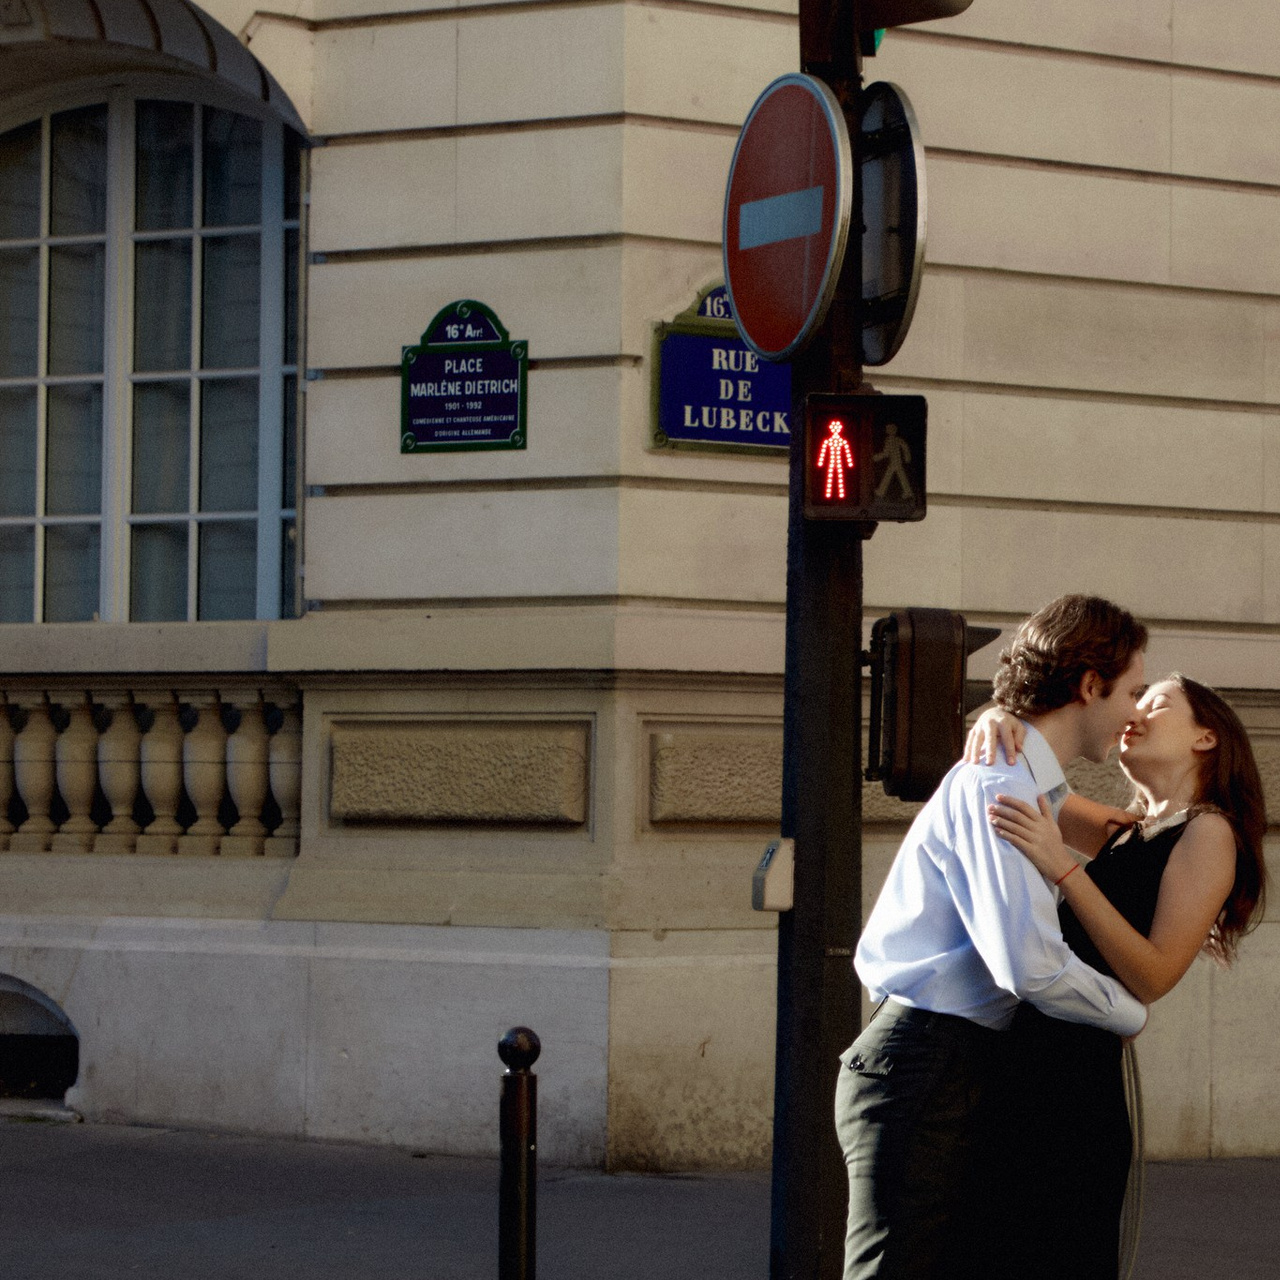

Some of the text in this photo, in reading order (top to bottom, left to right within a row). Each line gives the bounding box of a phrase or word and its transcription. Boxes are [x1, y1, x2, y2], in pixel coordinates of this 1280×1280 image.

[444, 358, 483, 374] PLACE
[711, 348, 760, 373] RUE
[464, 378, 518, 396] DIETRICH
[718, 378, 752, 402] DE
[445, 402, 460, 411] 1901
[466, 401, 482, 410] 1992
[683, 404, 791, 434] LUBECK
